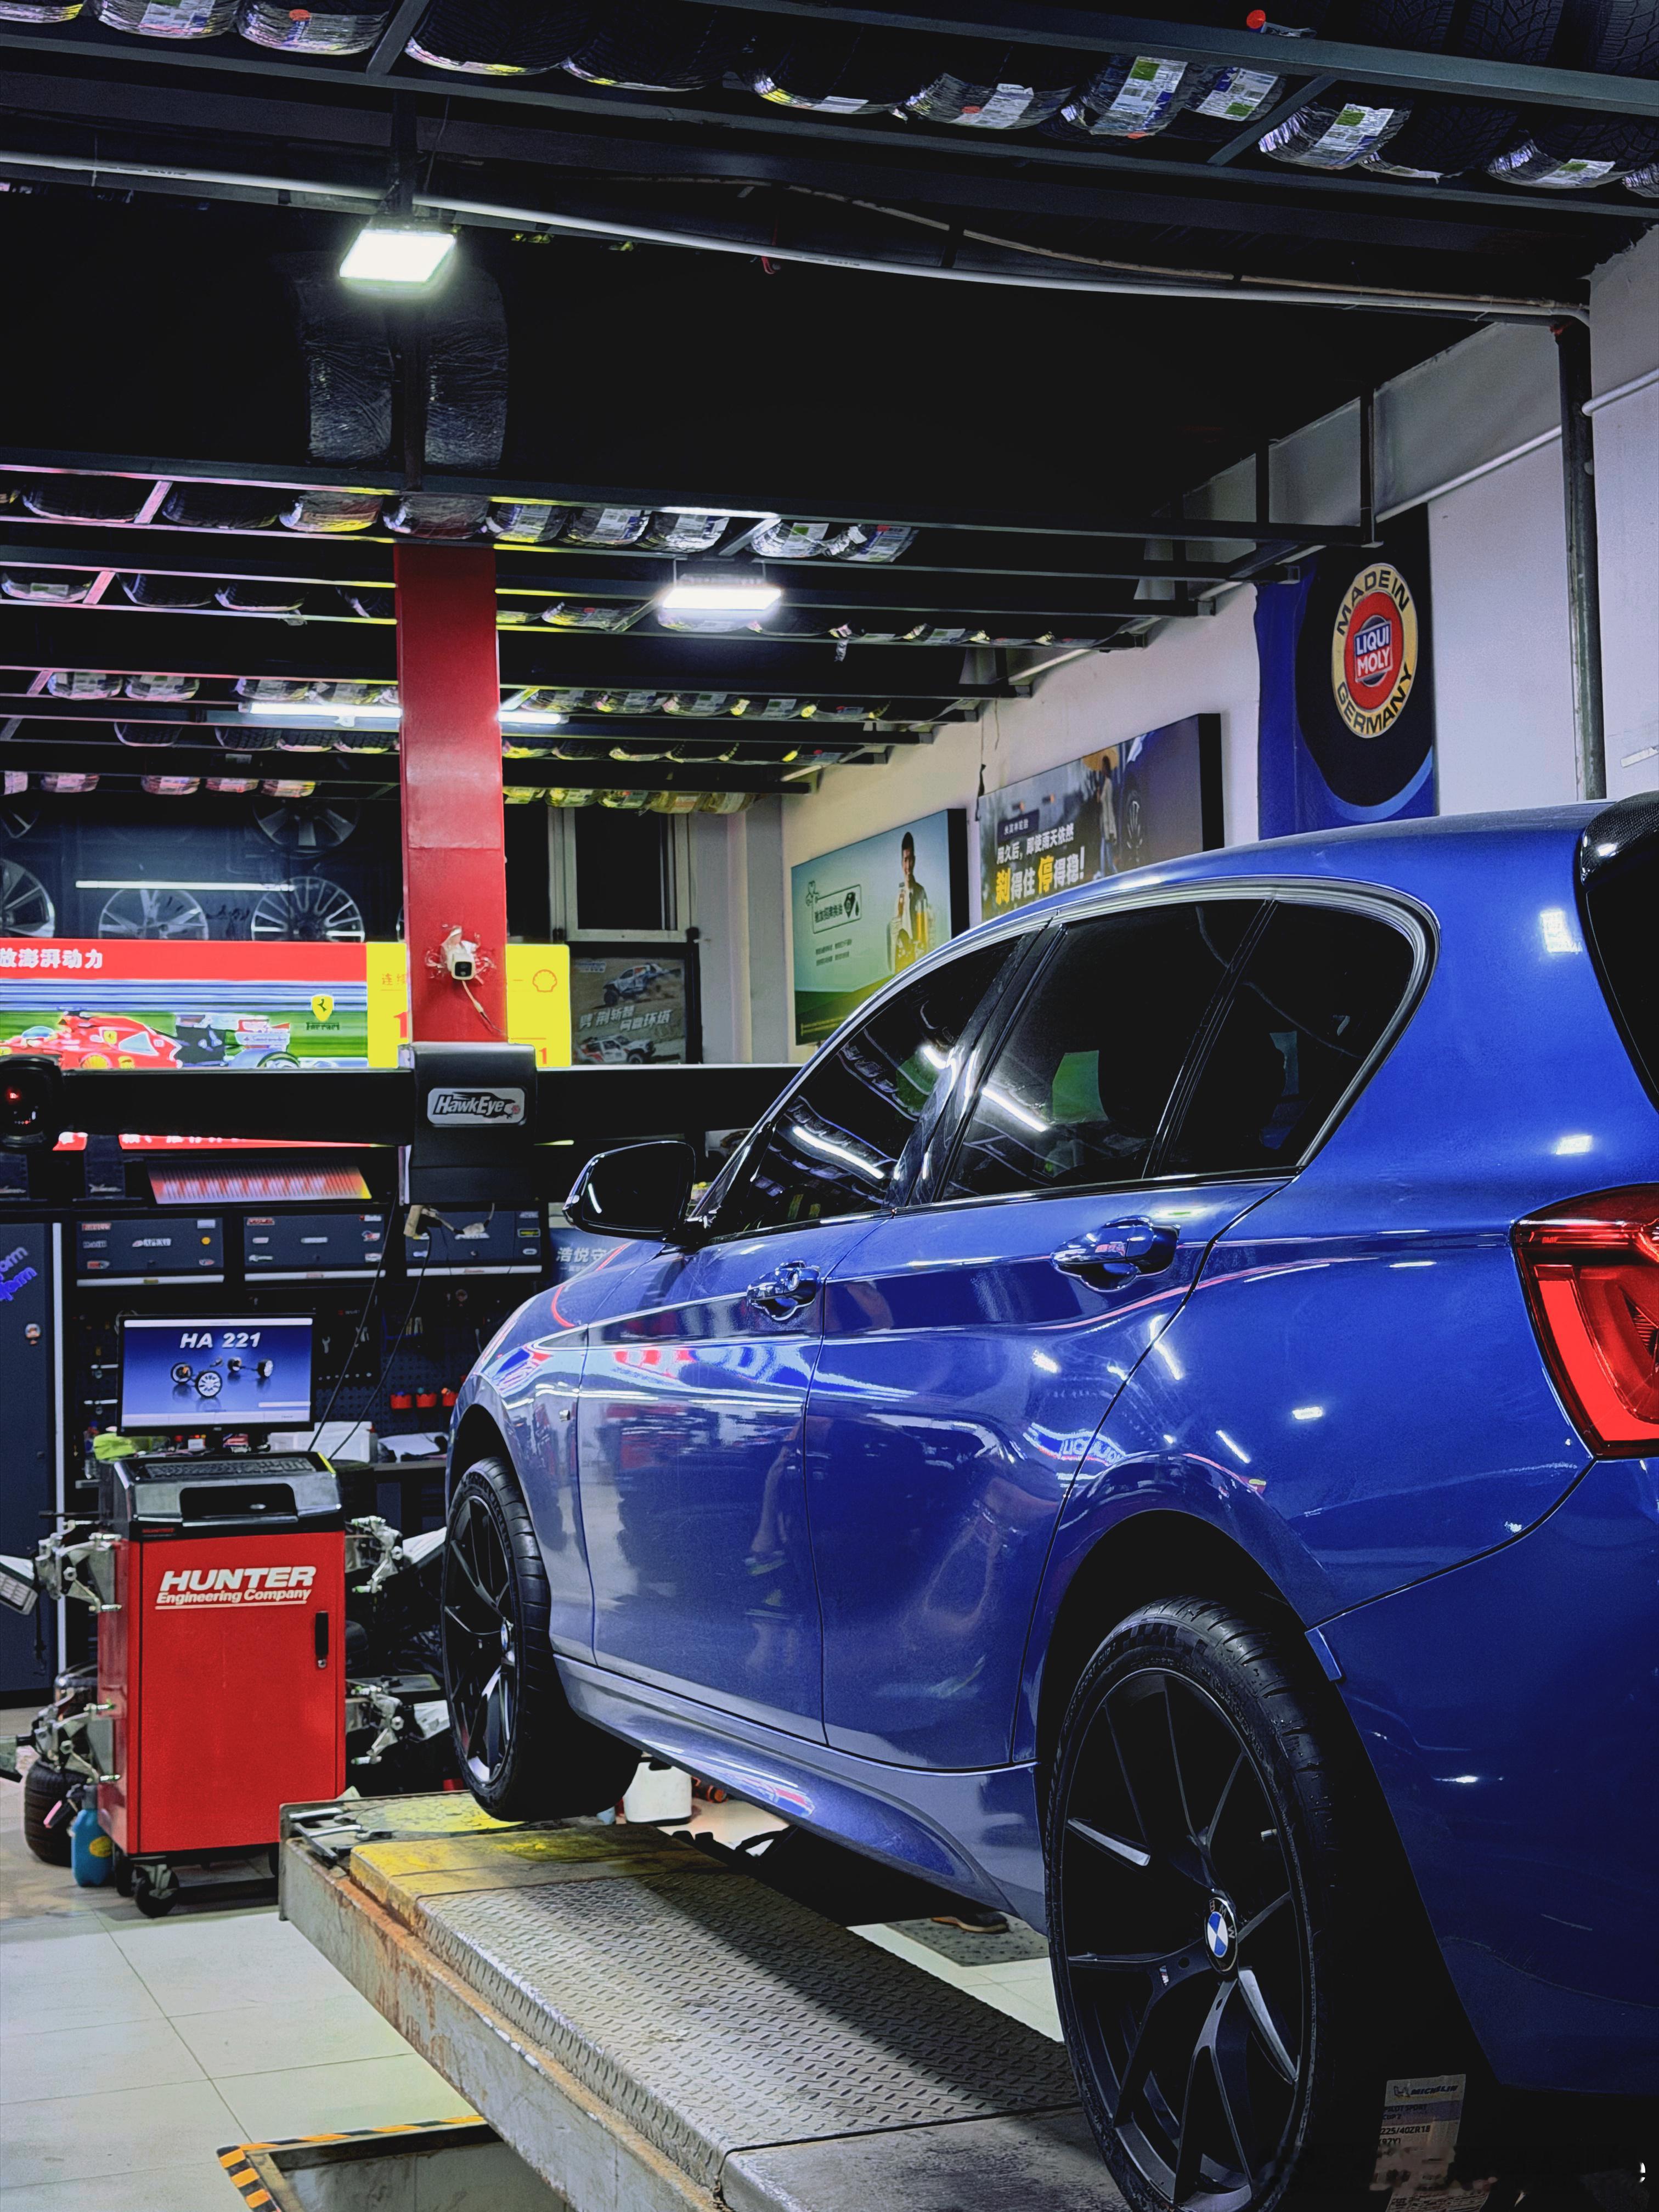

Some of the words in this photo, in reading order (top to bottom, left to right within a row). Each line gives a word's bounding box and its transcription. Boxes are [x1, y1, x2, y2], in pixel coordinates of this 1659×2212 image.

[1337, 569, 1391, 637] MADE
[1391, 578, 1410, 612] IN
[1356, 625, 1389, 656] LIQUI
[1357, 646, 1390, 676] MOLY
[1336, 661, 1412, 735] GERMANY
[435, 1095, 505, 1116] HawkEye
[180, 1333, 213, 1348] HA
[222, 1331, 261, 1348] 221
[160, 1566, 317, 1592] HUNTER
[156, 1591, 242, 1605] Engineering
[244, 1589, 312, 1601] Company
[1209, 1900, 1235, 1939] BMW
[1410, 2085, 1458, 2095] MICHELIN
[1380, 2125, 1431, 2135] 225/40ZR18
